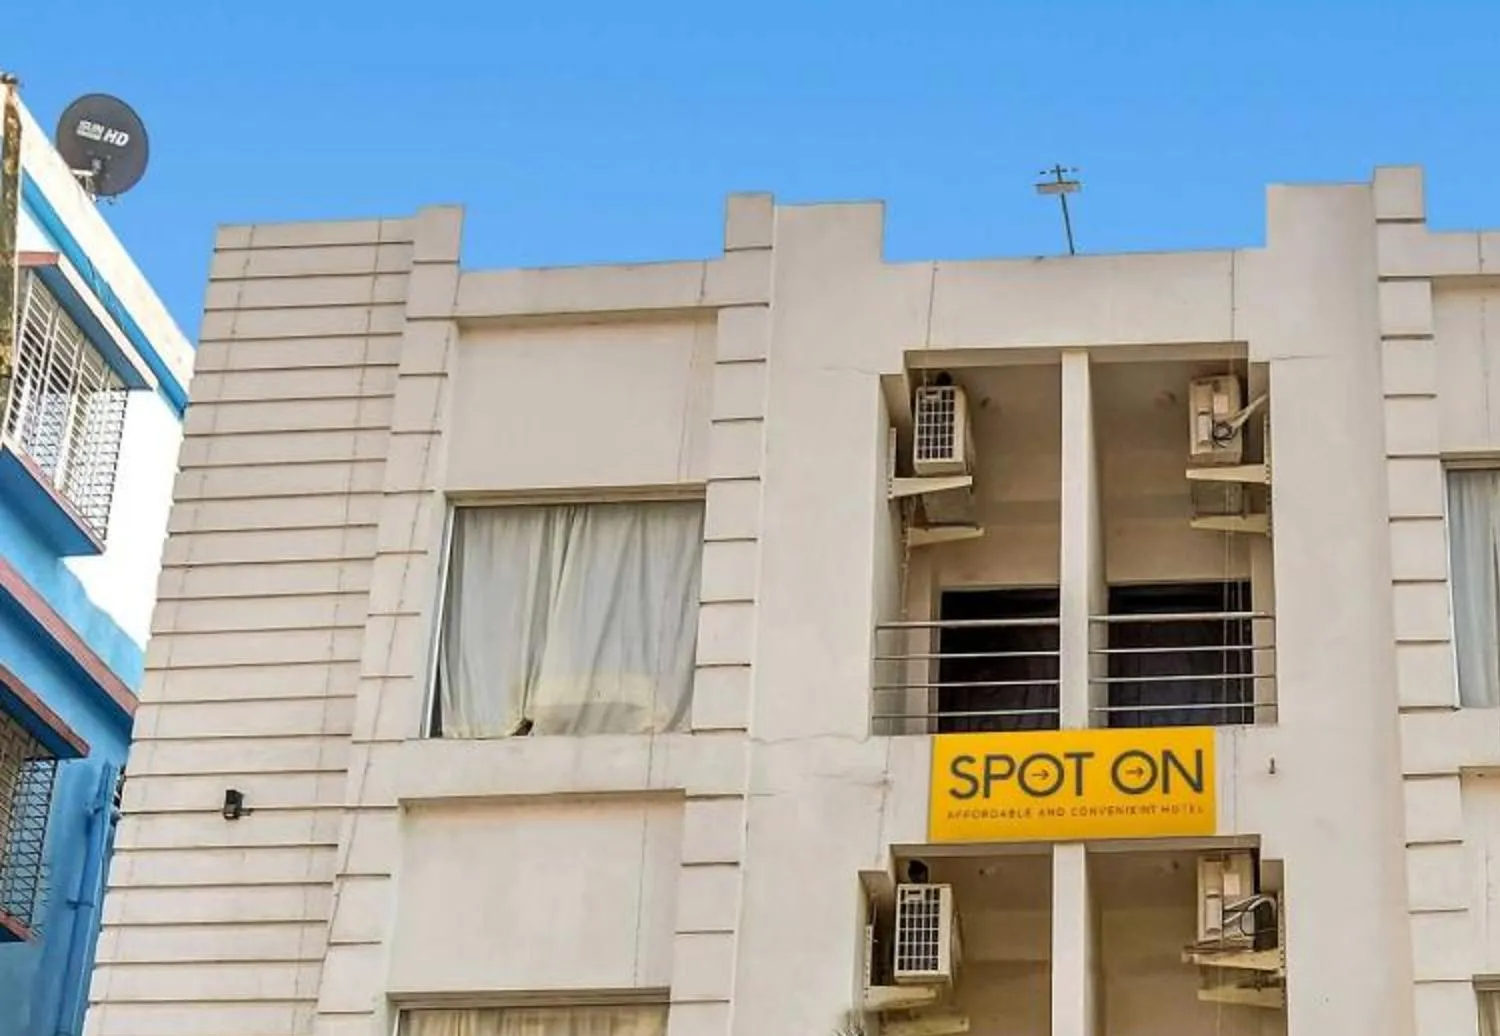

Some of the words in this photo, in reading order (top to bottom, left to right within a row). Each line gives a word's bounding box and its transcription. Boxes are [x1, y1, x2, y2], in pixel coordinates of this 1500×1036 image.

[949, 751, 1094, 800] SPOT
[1111, 749, 1204, 795] ON
[1038, 805, 1065, 817] AND
